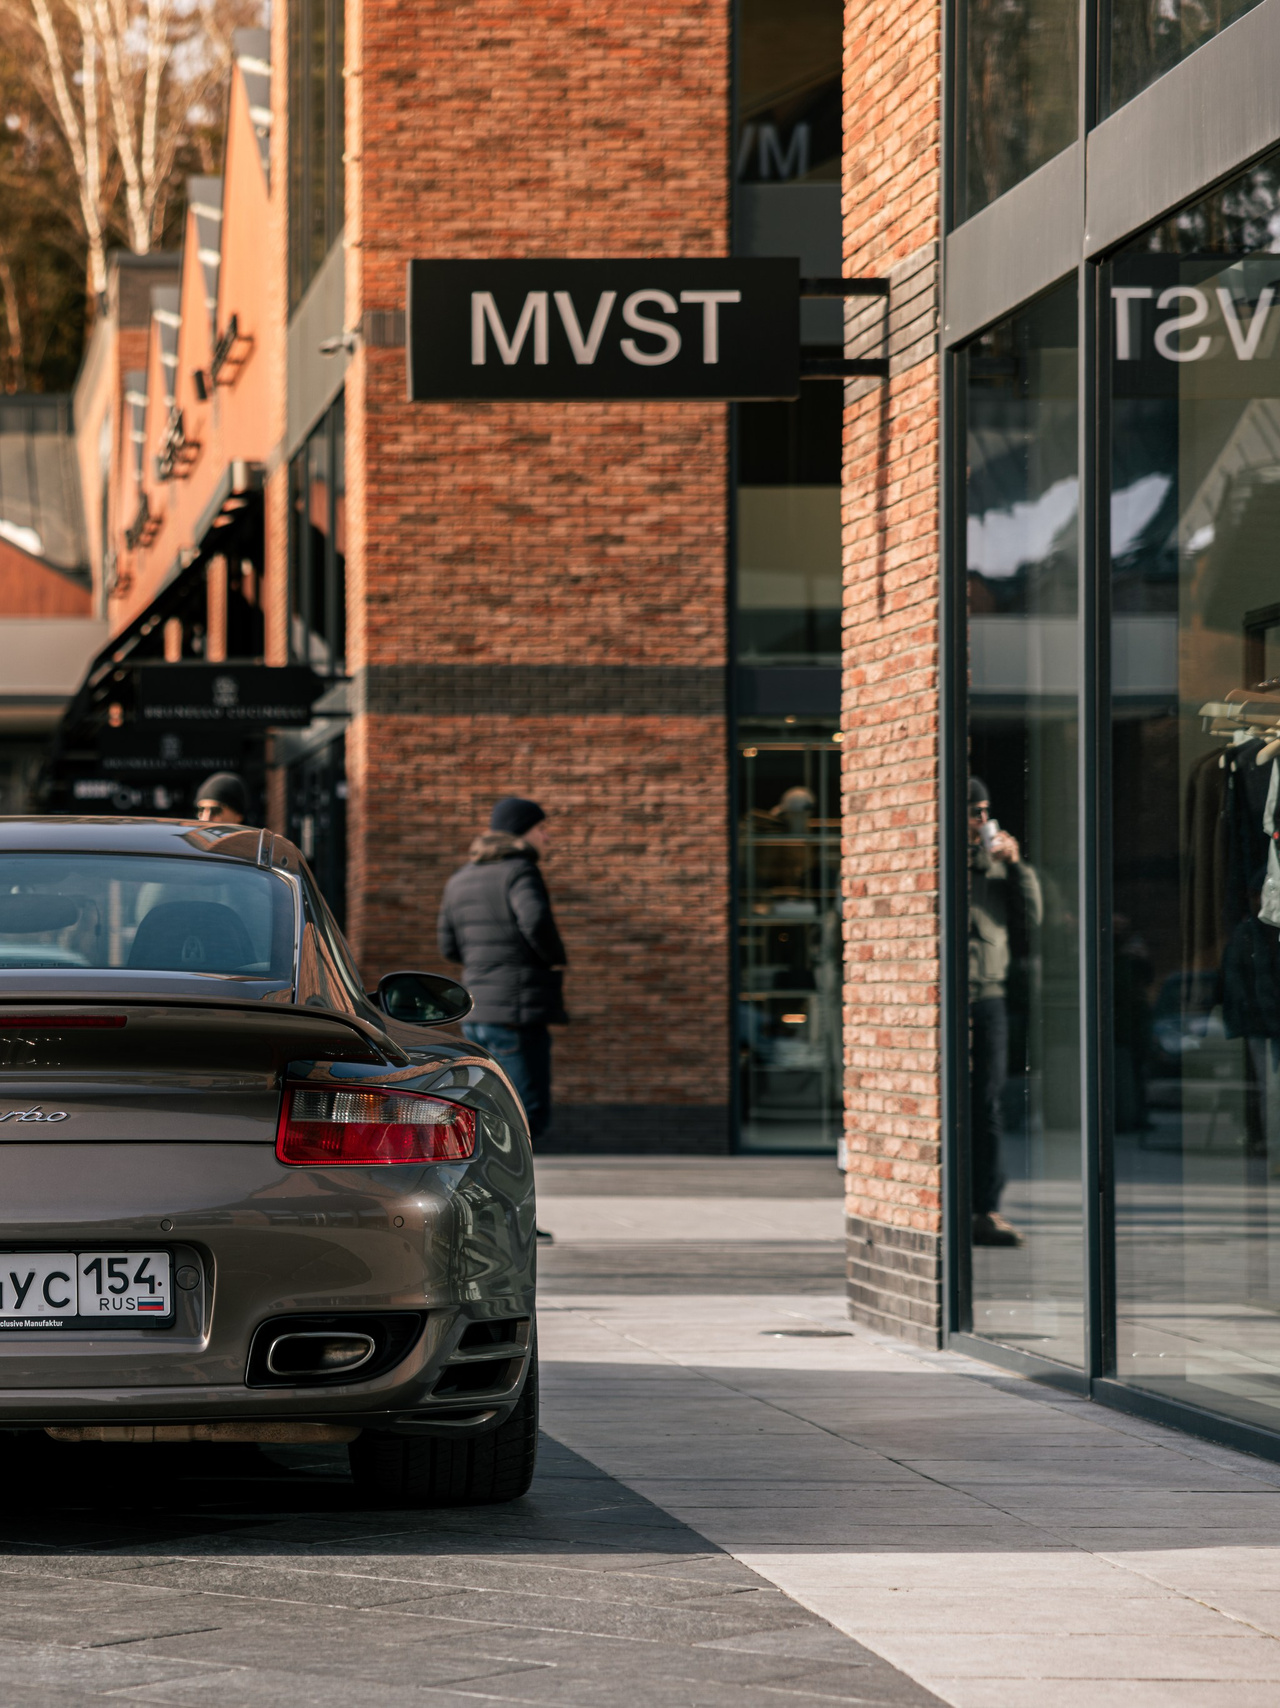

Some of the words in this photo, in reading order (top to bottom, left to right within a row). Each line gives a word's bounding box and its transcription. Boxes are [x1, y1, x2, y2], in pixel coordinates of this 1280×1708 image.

[470, 289, 741, 366] MVST
[83, 1257, 155, 1294] 154
[99, 1297, 136, 1311] RUS
[24, 1319, 63, 1327] Manufaktur
